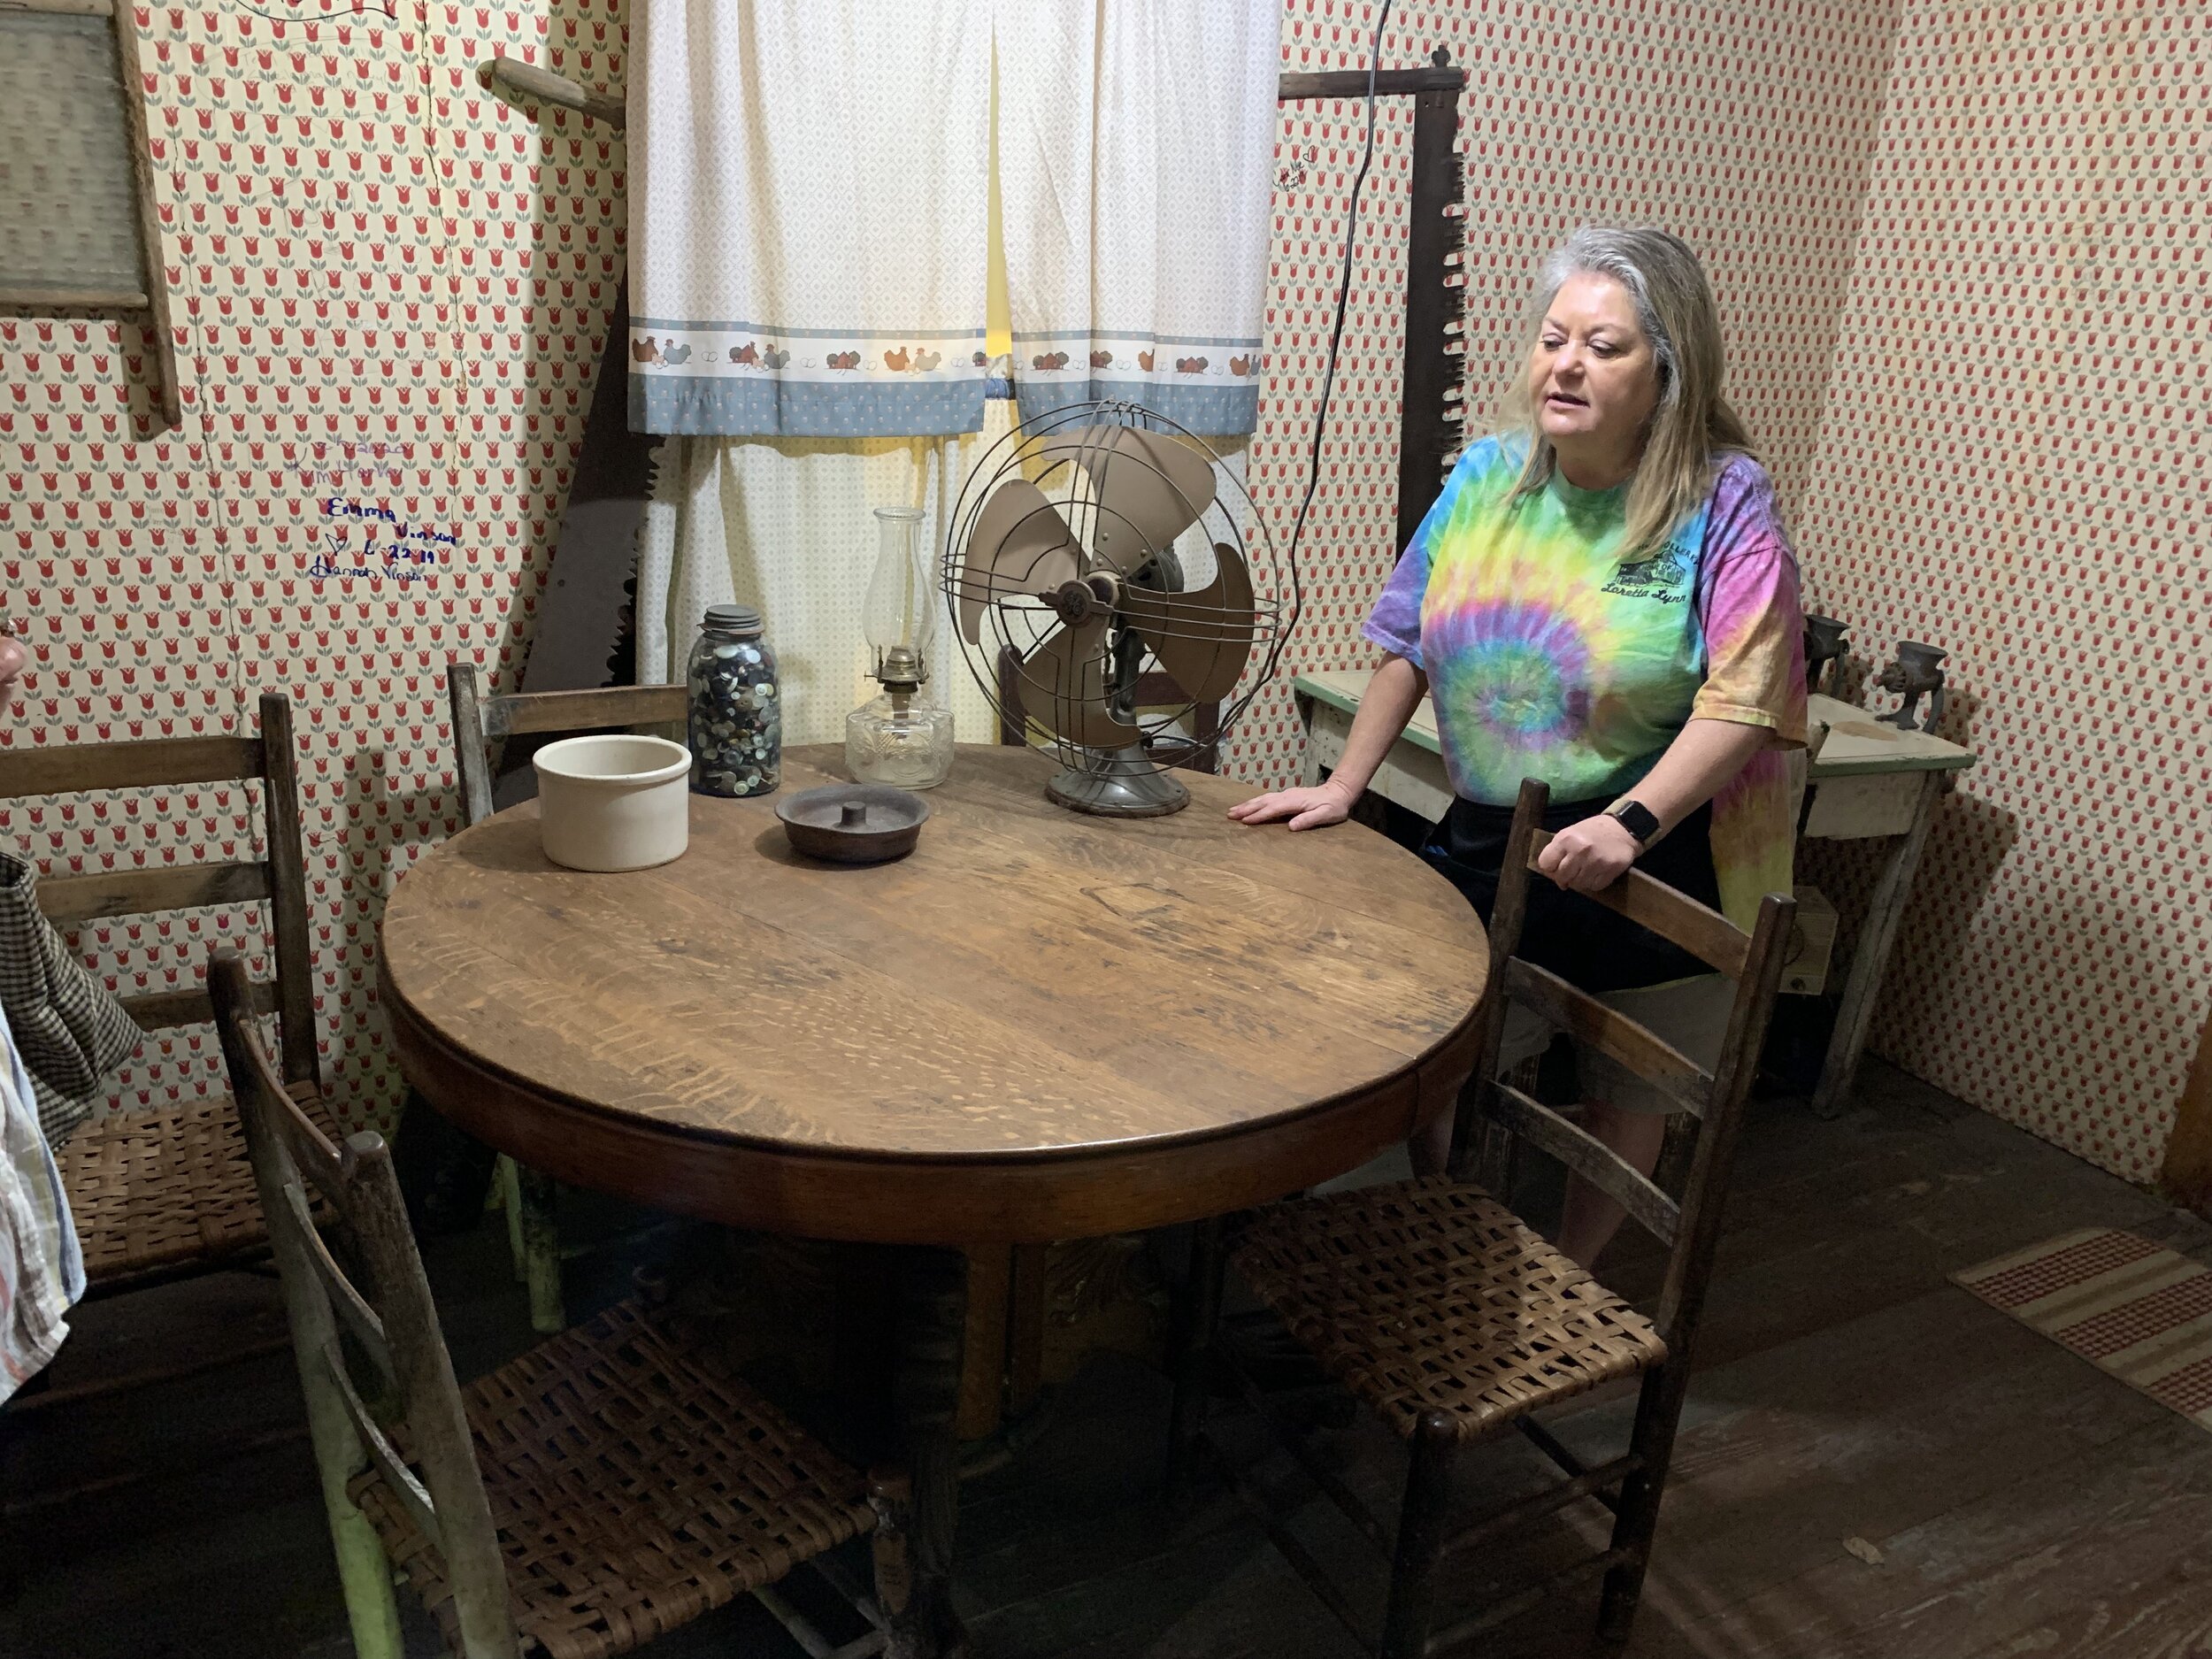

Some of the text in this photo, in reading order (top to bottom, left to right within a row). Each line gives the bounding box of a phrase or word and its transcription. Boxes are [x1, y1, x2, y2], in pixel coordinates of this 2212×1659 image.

[326, 496, 396, 523] Emma
[1601, 582, 1686, 604] Loretta Lynn
